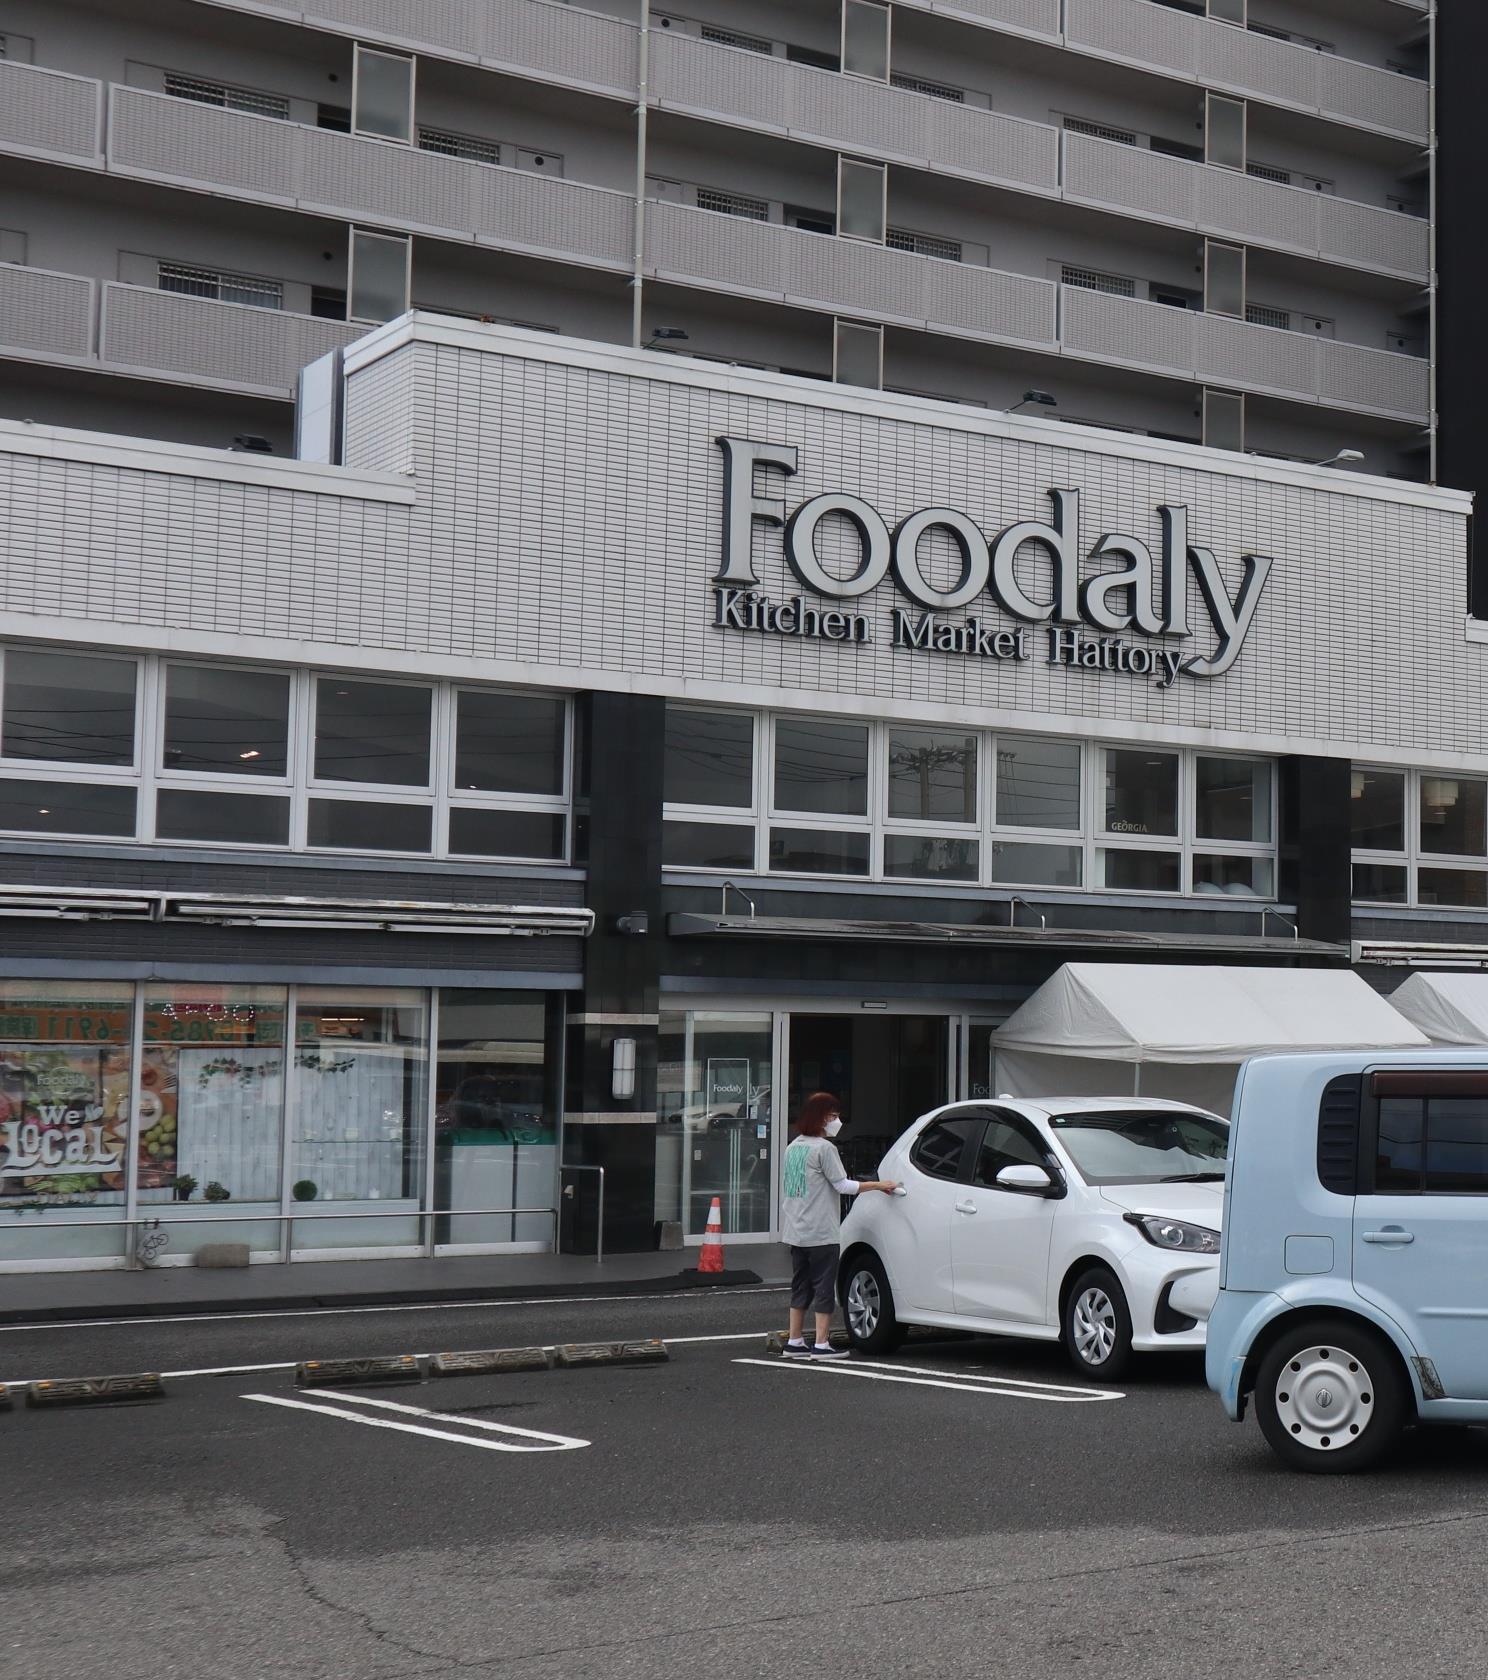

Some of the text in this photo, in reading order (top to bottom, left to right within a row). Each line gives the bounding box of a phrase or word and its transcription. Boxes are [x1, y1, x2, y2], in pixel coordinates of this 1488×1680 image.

[711, 435, 1274, 679] Foodaly
[712, 586, 1186, 688] Kitchen Market Hattory
[37, 1104, 81, 1126] We
[713, 1083, 744, 1093] Foodaly
